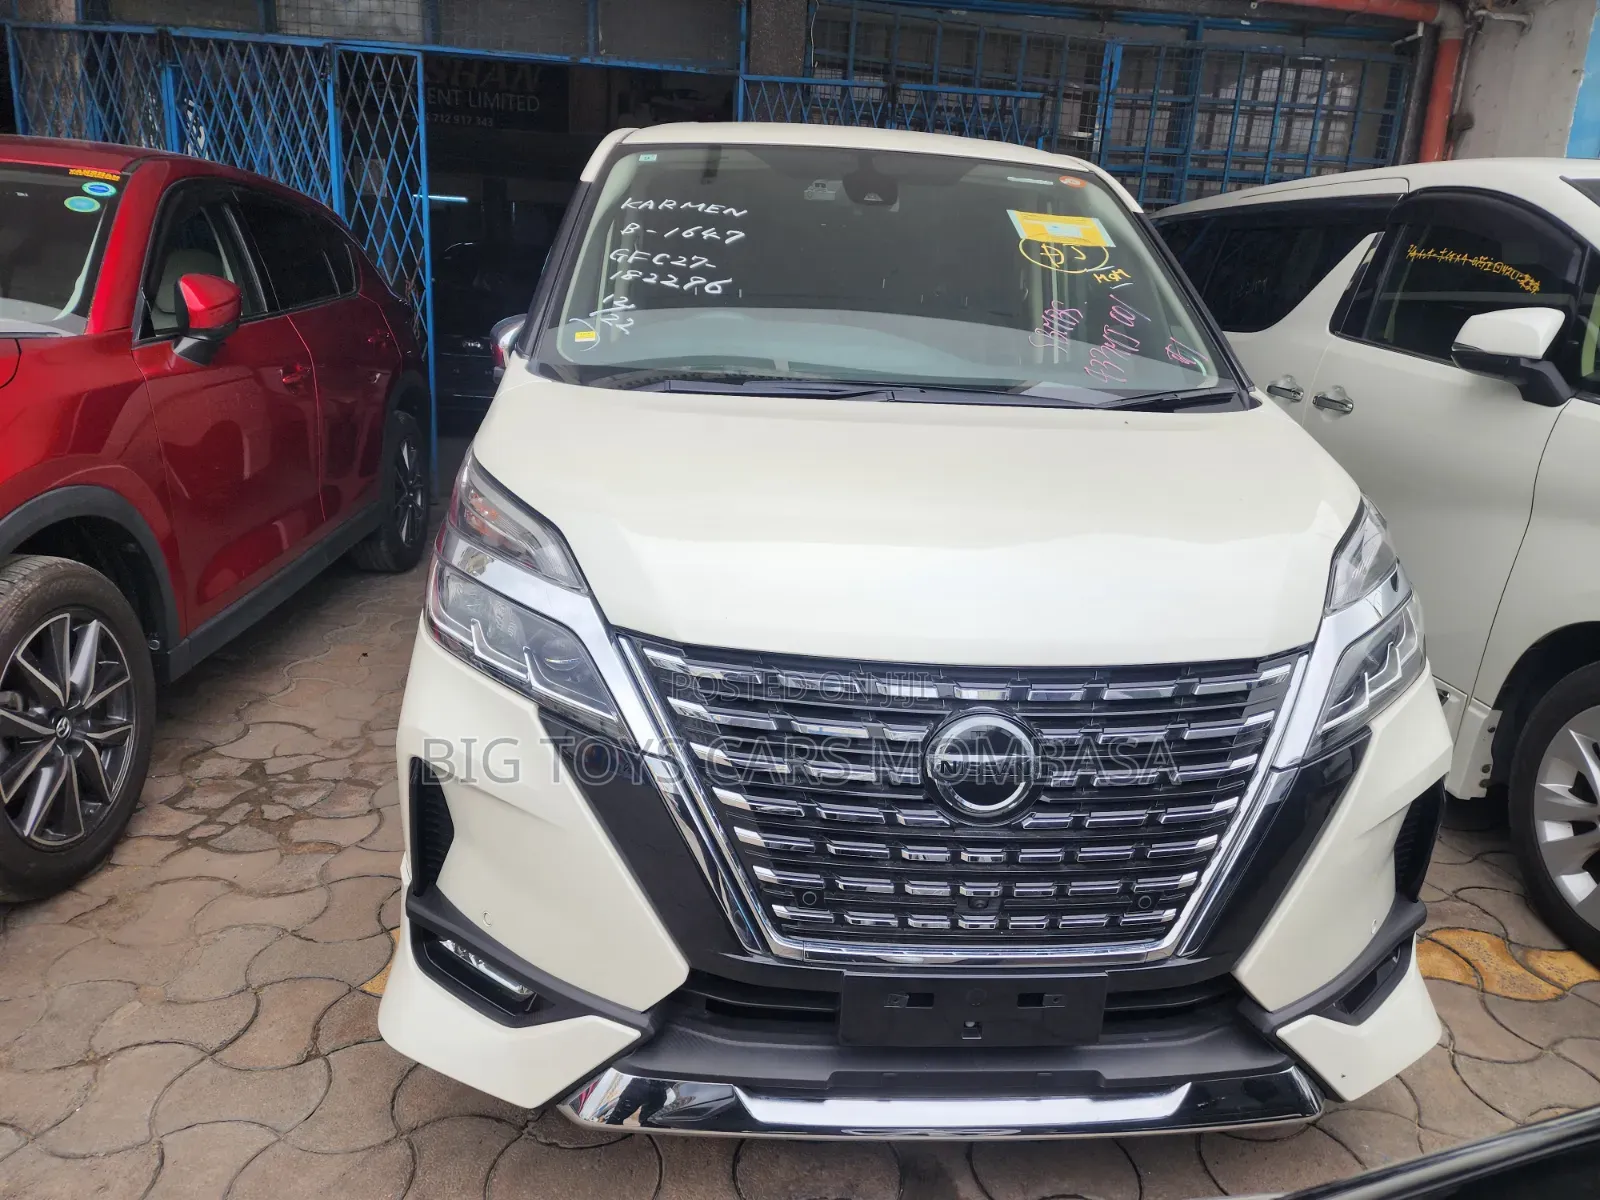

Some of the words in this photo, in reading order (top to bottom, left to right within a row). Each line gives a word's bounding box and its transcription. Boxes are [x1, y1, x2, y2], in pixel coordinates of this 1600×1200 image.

[468, 90, 540, 112] LIMITED
[433, 113, 450, 124] 712
[453, 114, 473, 126] 917
[620, 197, 748, 217] KARMEN
